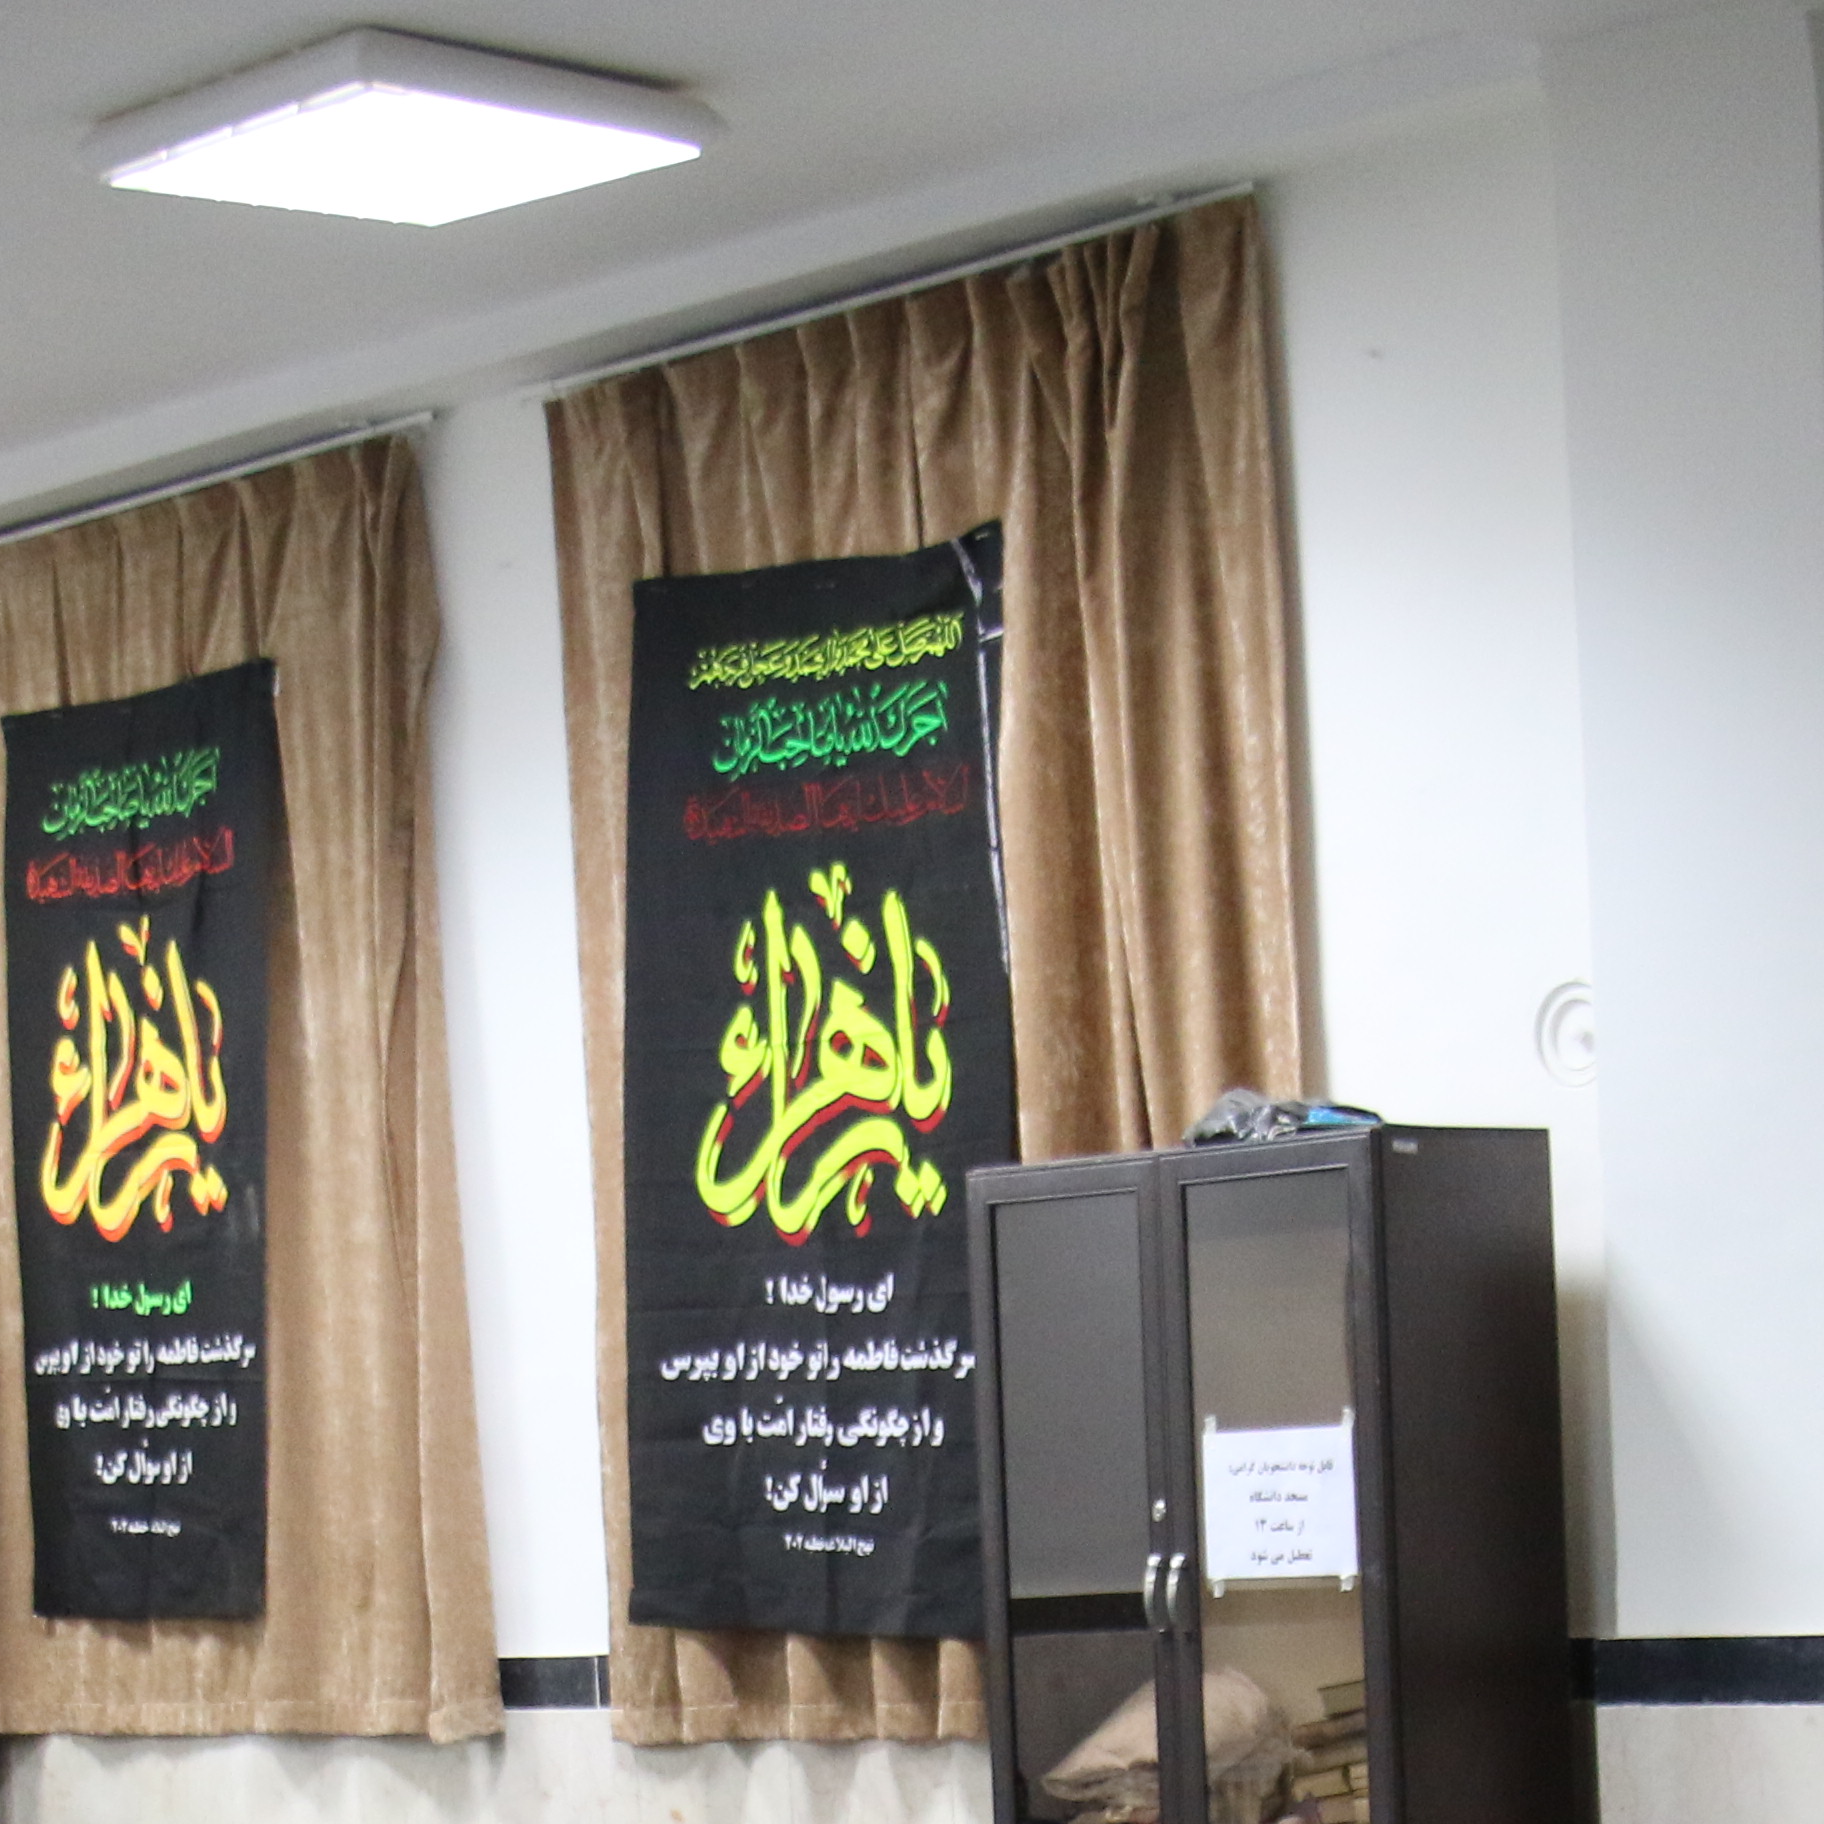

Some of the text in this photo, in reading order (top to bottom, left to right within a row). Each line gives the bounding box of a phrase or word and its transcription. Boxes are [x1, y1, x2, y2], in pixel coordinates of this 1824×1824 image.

[103, 1283, 133, 1309] خدا
[135, 1281, 171, 1316] رسول
[174, 1280, 193, 1314] ای
[780, 1275, 813, 1305] خدا
[814, 1274, 864, 1314] رسول
[867, 1271, 894, 1313] ای
[61, 1339, 79, 1374] او
[80, 1341, 96, 1374] از
[97, 1341, 125, 1374] خود
[126, 1340, 142, 1374] تو
[144, 1338, 155, 1374] را
[157, 1336, 199, 1364] فاطمه
[661, 1348, 720, 1382] بپرس
[722, 1340, 746, 1381] او
[745, 1340, 766, 1381] از
[767, 1340, 804, 1381] خود
[806, 1340, 824, 1381] تو
[823, 1340, 841, 1380] را
[842, 1337, 899, 1370] فاطمه
[72, 1395, 87, 1428] با
[121, 1395, 155, 1429] رفتار
[156, 1395, 210, 1428] چگونگی
[212, 1391, 228, 1427] از
[741, 1405, 754, 1444] با
[794, 1405, 835, 1447] رفتار
[837, 1405, 910, 1447] چگونگی
[911, 1405, 931, 1447] از
[702, 1413, 737, 1446] وی
[931, 1415, 944, 1447] و
[161, 1451, 177, 1485] او
[178, 1450, 193, 1485] از
[849, 1473, 869, 1514] او
[869, 1473, 888, 1515] از
